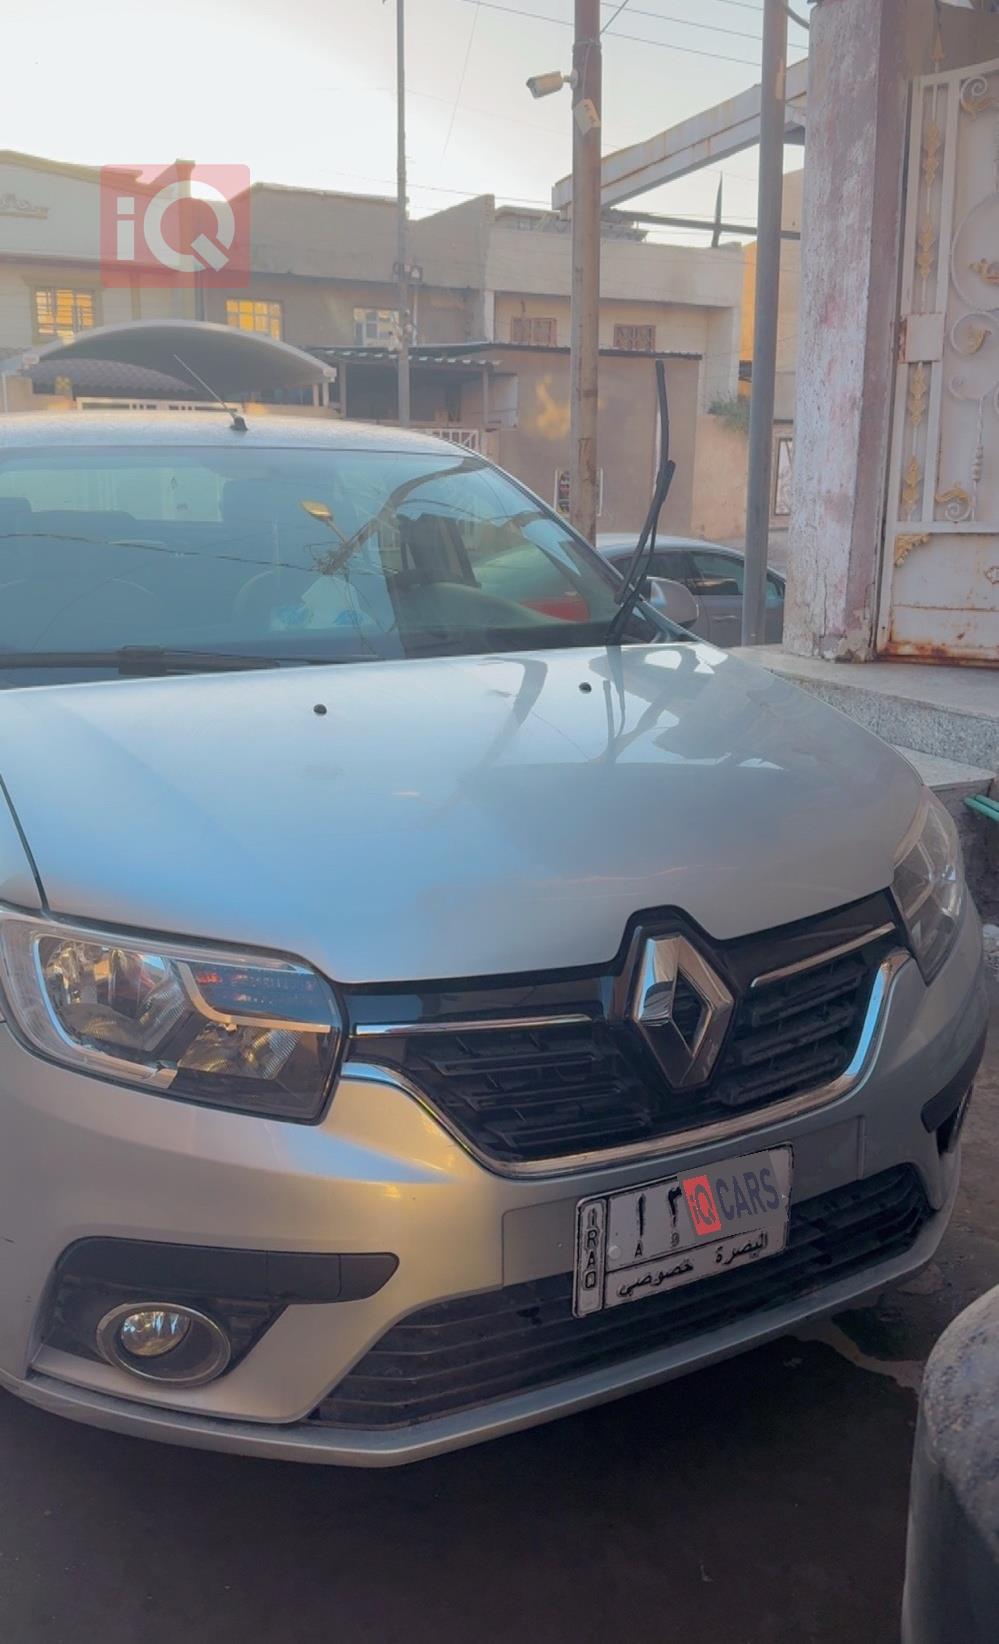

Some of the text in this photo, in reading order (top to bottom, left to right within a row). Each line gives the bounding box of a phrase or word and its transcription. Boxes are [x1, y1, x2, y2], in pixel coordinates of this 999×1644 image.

[583, 1207, 599, 1290] IRAQ
[617, 1230, 769, 1298] البصرة خصوصي
